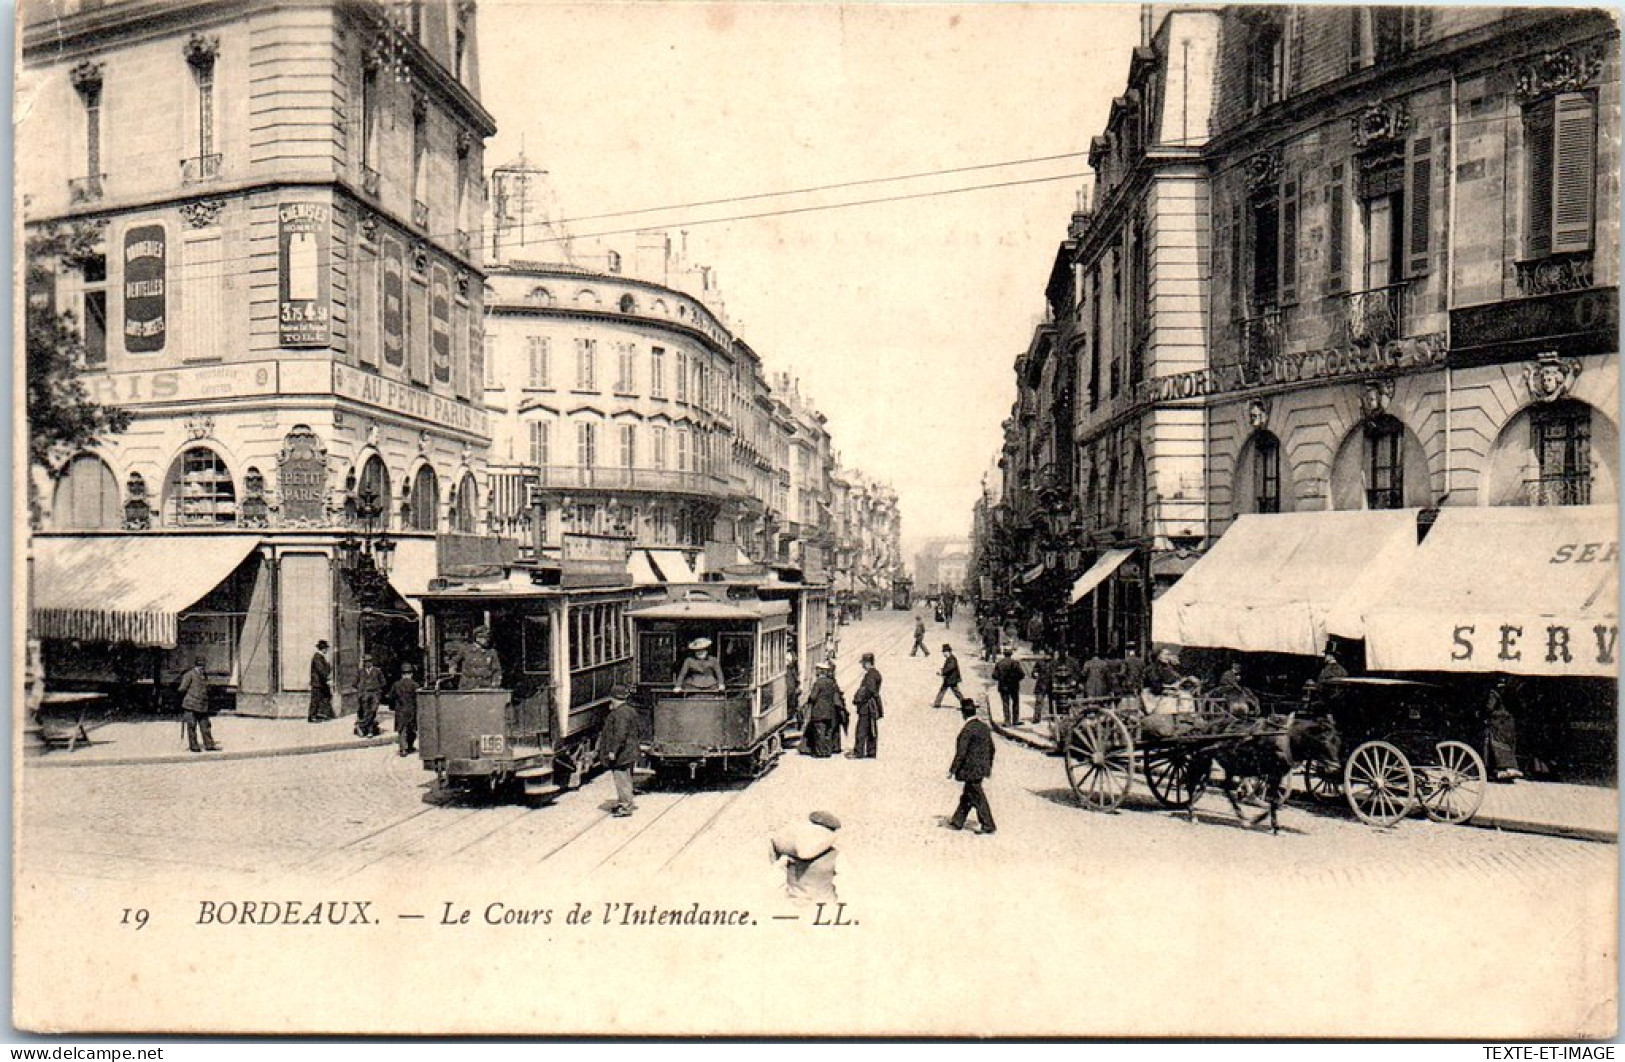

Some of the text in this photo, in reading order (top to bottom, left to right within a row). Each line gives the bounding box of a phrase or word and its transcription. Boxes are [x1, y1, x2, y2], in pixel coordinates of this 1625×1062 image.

[280, 203, 328, 222] CHEMISES
[362, 375, 382, 403] AU
[388, 381, 429, 417] PETIT
[434, 397, 471, 430] PARIS
[285, 472, 320, 484] PETIT
[285, 488, 320, 501] PARIS
